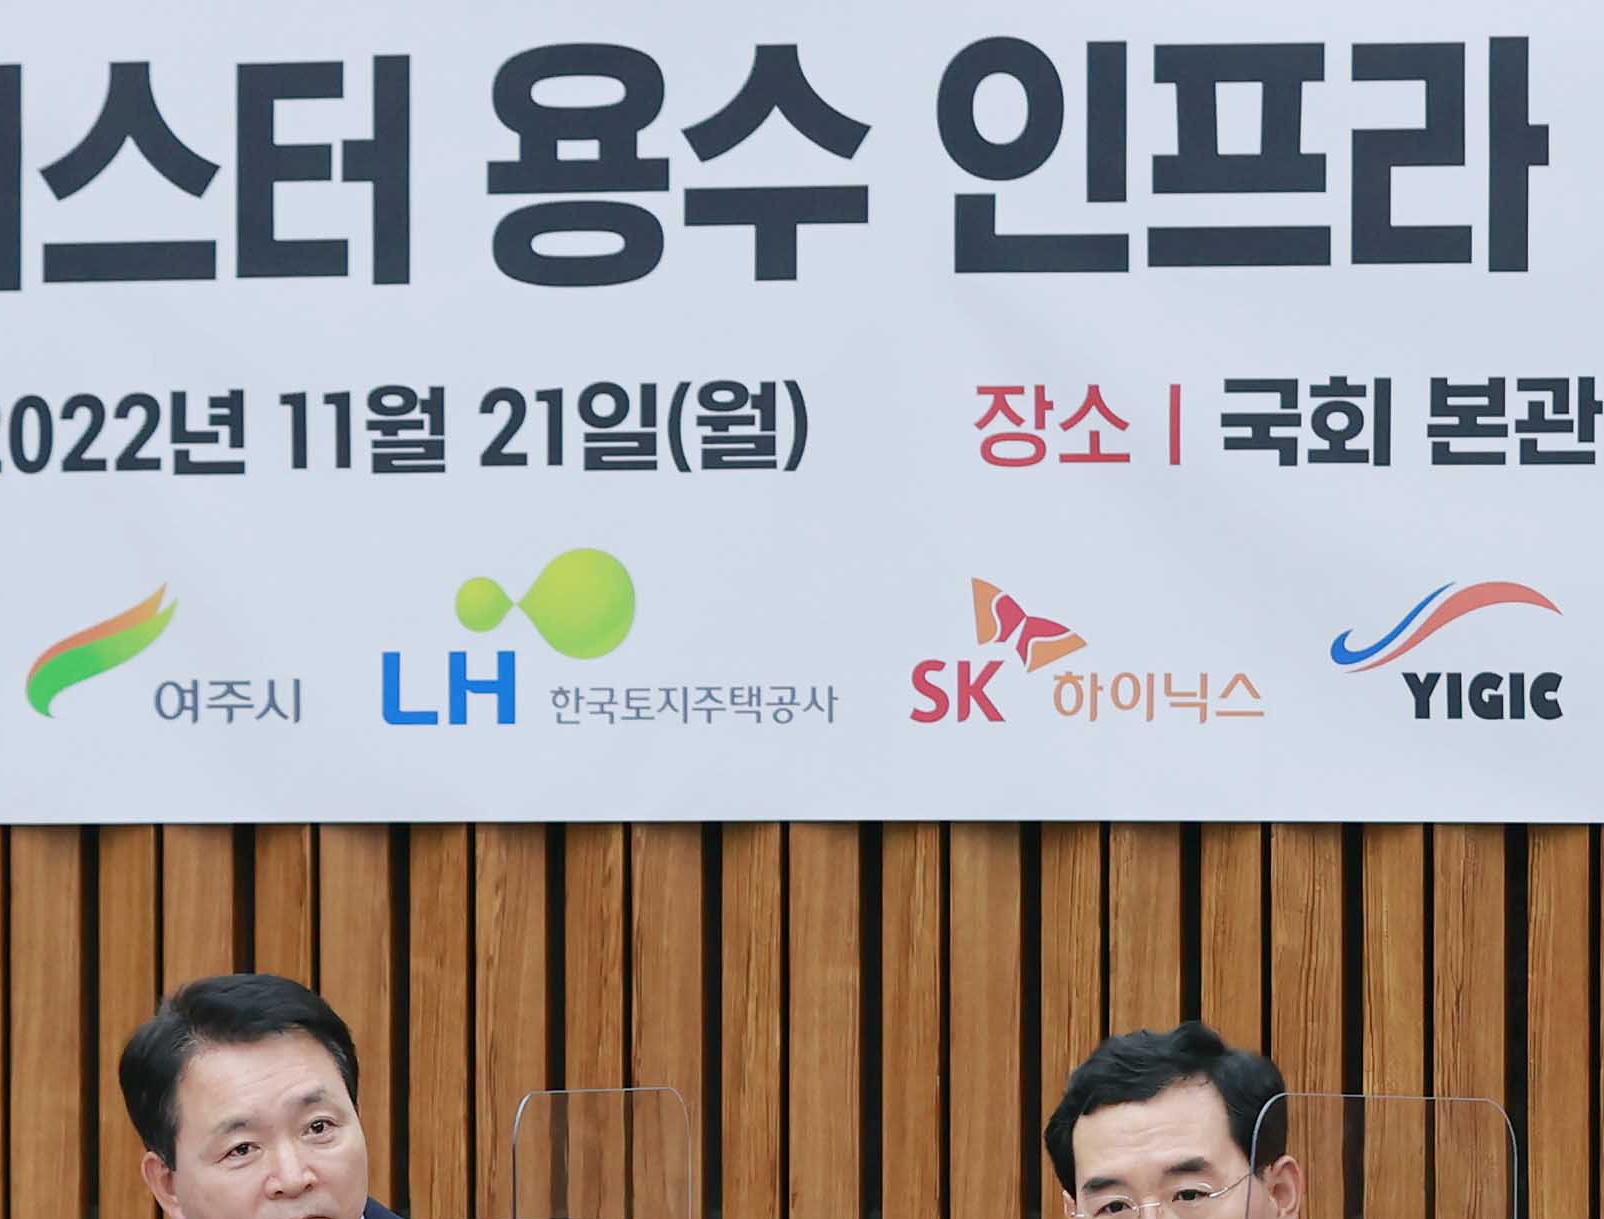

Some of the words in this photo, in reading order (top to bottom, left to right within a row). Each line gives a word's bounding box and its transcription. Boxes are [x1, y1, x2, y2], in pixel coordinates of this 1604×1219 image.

[484, 40, 874, 290] 용수
[934, 34, 1551, 276] 인프라
[278, 384, 447, 475] 11월
[478, 379, 809, 474] 21일(월)
[973, 383, 1131, 468] 장소
[1219, 375, 1393, 468] 국회
[1426, 375, 1604, 466] 본관
[153, 677, 302, 726] 여주시
[381, 649, 517, 727] LH
[549, 684, 840, 726] 한국토지주택공사
[908, 658, 1007, 724] SK
[1052, 670, 1265, 724] 하이닉스
[1400, 670, 1564, 721] YIGIC
